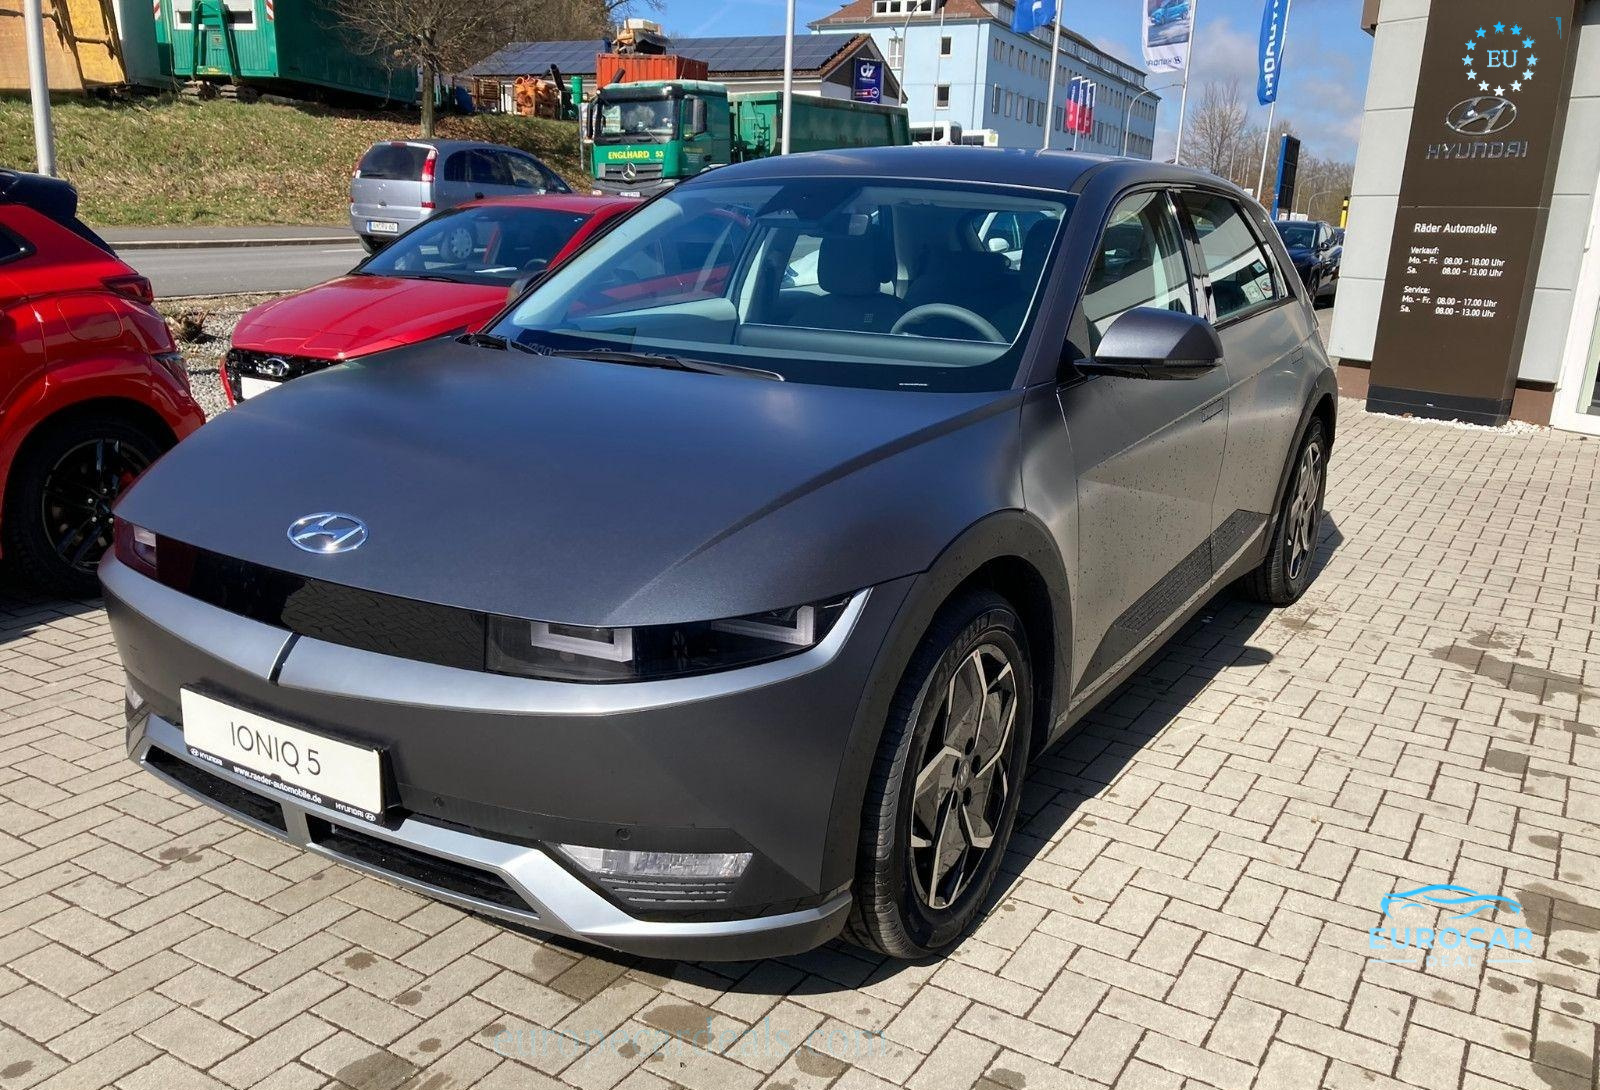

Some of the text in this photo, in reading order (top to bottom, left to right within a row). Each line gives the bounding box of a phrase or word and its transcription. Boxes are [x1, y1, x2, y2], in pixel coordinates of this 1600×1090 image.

[608, 150, 650, 160] ENGLHARD
[1426, 141, 1529, 160] HYUNDAI
[1414, 223, 1498, 234] Räder Automobile
[1410, 247, 1440, 255] Verkauf:
[1443, 257, 1463, 266] 08.00
[1471, 258, 1490, 266] 18.00
[1491, 259, 1505, 267] Uhr
[1406, 266, 1417, 274] Sa.
[1442, 267, 1461, 275] 08.00
[1469, 268, 1488, 276] 13.00
[1489, 269, 1503, 277] Uhr
[1404, 285, 1431, 294] Service:
[1401, 295, 1414, 303] Mo.
[1422, 296, 1431, 304] Fr.
[1437, 297, 1456, 306] 08.00
[1463, 298, 1482, 307] 17.00
[1483, 299, 1497, 308] Uhr
[1435, 307, 1454, 315] 08.00
[1462, 308, 1480, 317] 13.00
[1481, 310, 1495, 318] Uhr
[230, 721, 321, 776] IONIQ 5
[199, 751, 223, 766] HYUNDAI
[233, 766, 322, 804] www.raeder-automobile.de
[335, 802, 364, 818] HYUNDAI
